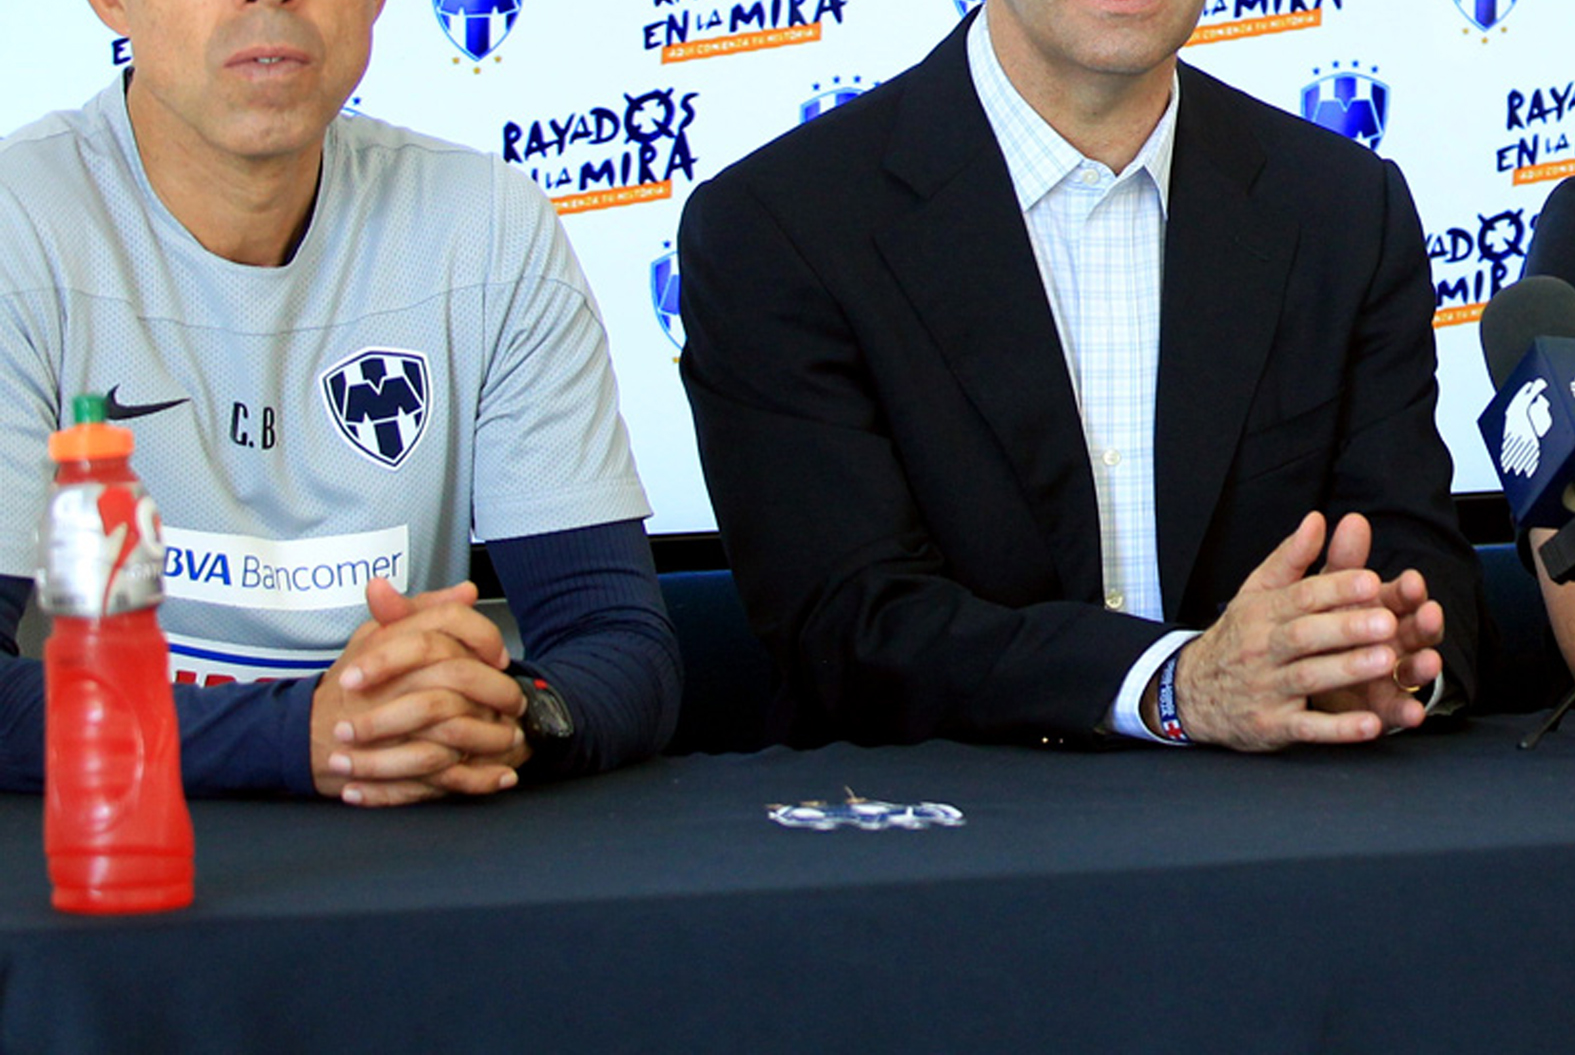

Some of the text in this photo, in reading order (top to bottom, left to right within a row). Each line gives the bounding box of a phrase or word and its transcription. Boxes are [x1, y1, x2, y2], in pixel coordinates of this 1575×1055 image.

[643, 10, 688, 49] EN
[697, 9, 721, 30] LA
[111, 36, 132, 66] E
[502, 87, 698, 164] RAYADOS
[545, 130, 698, 189] LA MIRA
[1497, 135, 1538, 171] EN
[1547, 133, 1569, 153] LA
[242, 550, 403, 592] Bancomer
